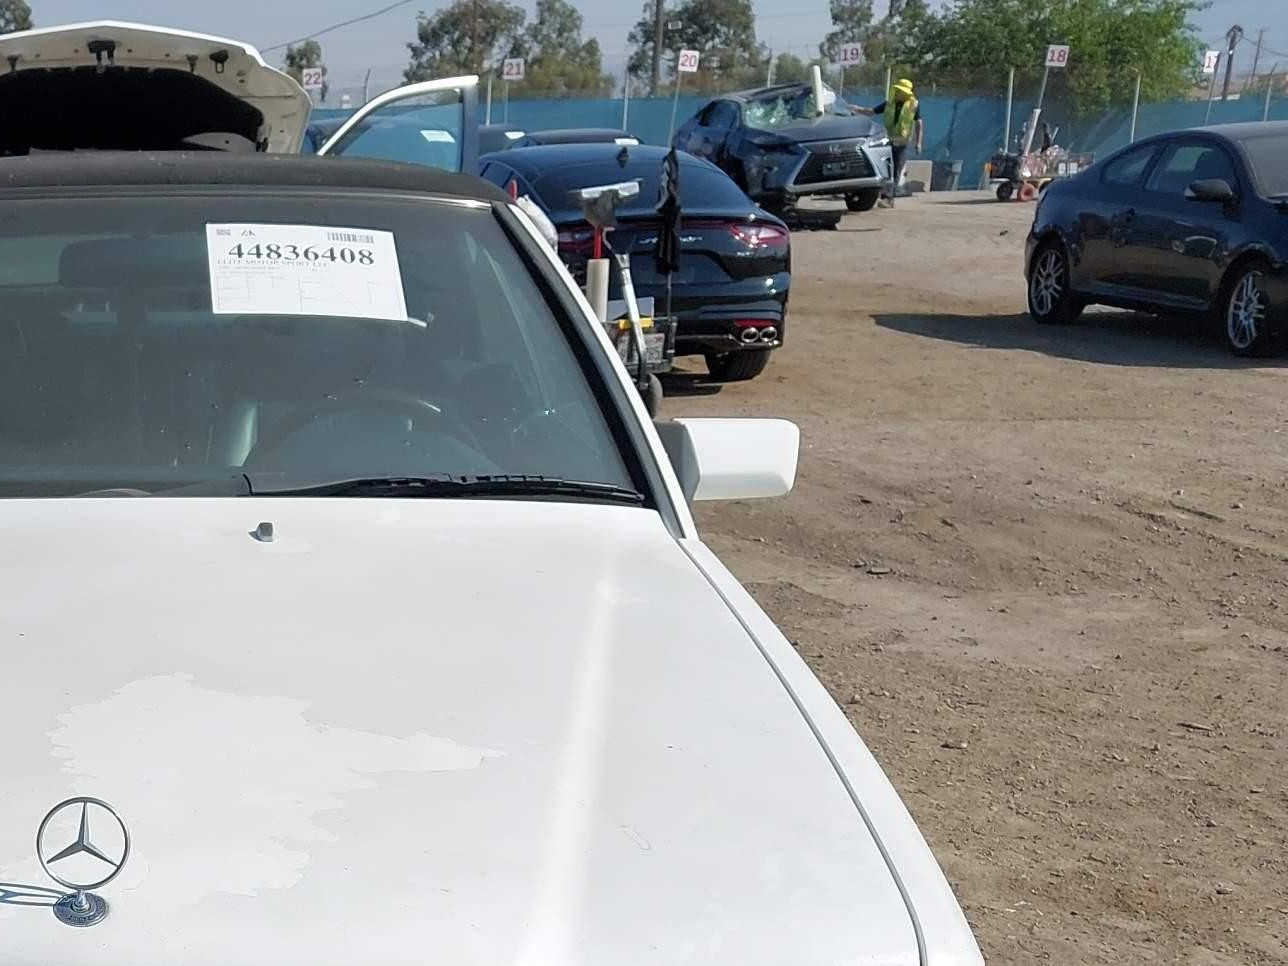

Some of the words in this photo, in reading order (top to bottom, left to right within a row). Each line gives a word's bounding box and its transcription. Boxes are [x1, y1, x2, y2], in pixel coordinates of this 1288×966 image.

[680, 54, 697, 68] 20
[841, 47, 859, 61] 19
[1048, 49, 1067, 63] 18
[504, 62, 523, 77] 21
[304, 72, 322, 86] 22
[228, 242, 375, 266] 44836408
